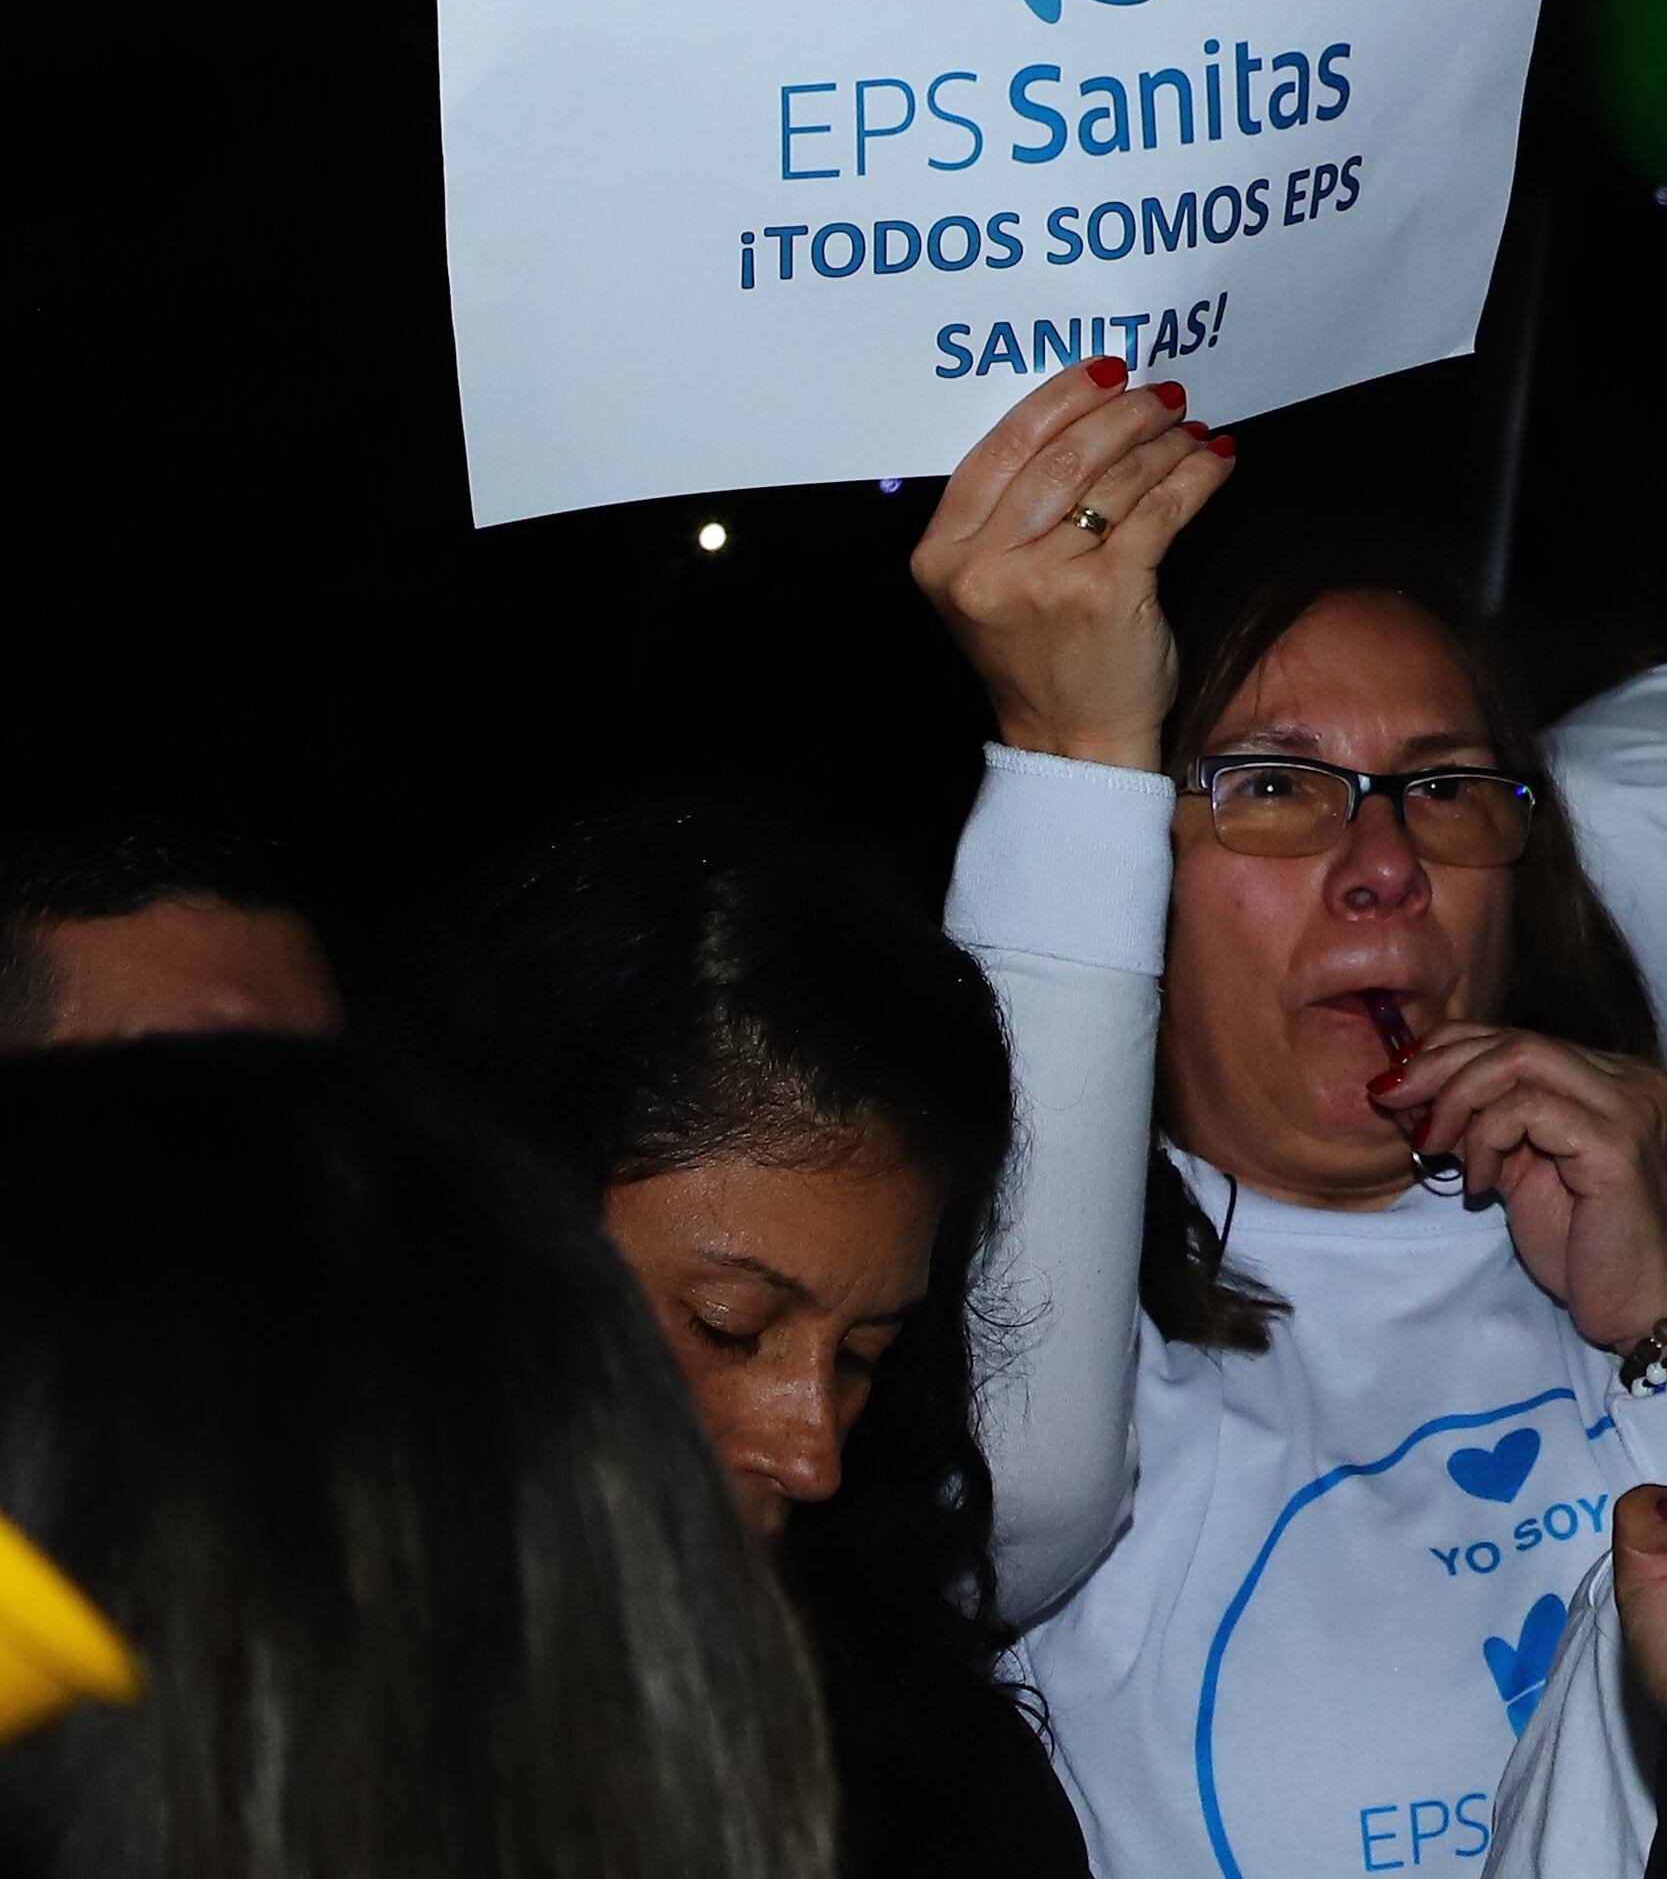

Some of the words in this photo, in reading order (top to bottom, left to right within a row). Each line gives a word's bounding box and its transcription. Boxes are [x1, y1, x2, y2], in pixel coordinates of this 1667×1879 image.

[780, 71, 984, 181] EPS
[1008, 38, 1352, 165] Sanitas
[740, 211, 1024, 290] ¡TODOS
[1046, 178, 1270, 266] SOMOS
[1282, 154, 1363, 228] EPS
[935, 290, 1229, 379] SANITAS!
[1429, 1541, 1502, 1576] YO
[1513, 1493, 1609, 1552] SOY
[1359, 1793, 1491, 1872] EPS
